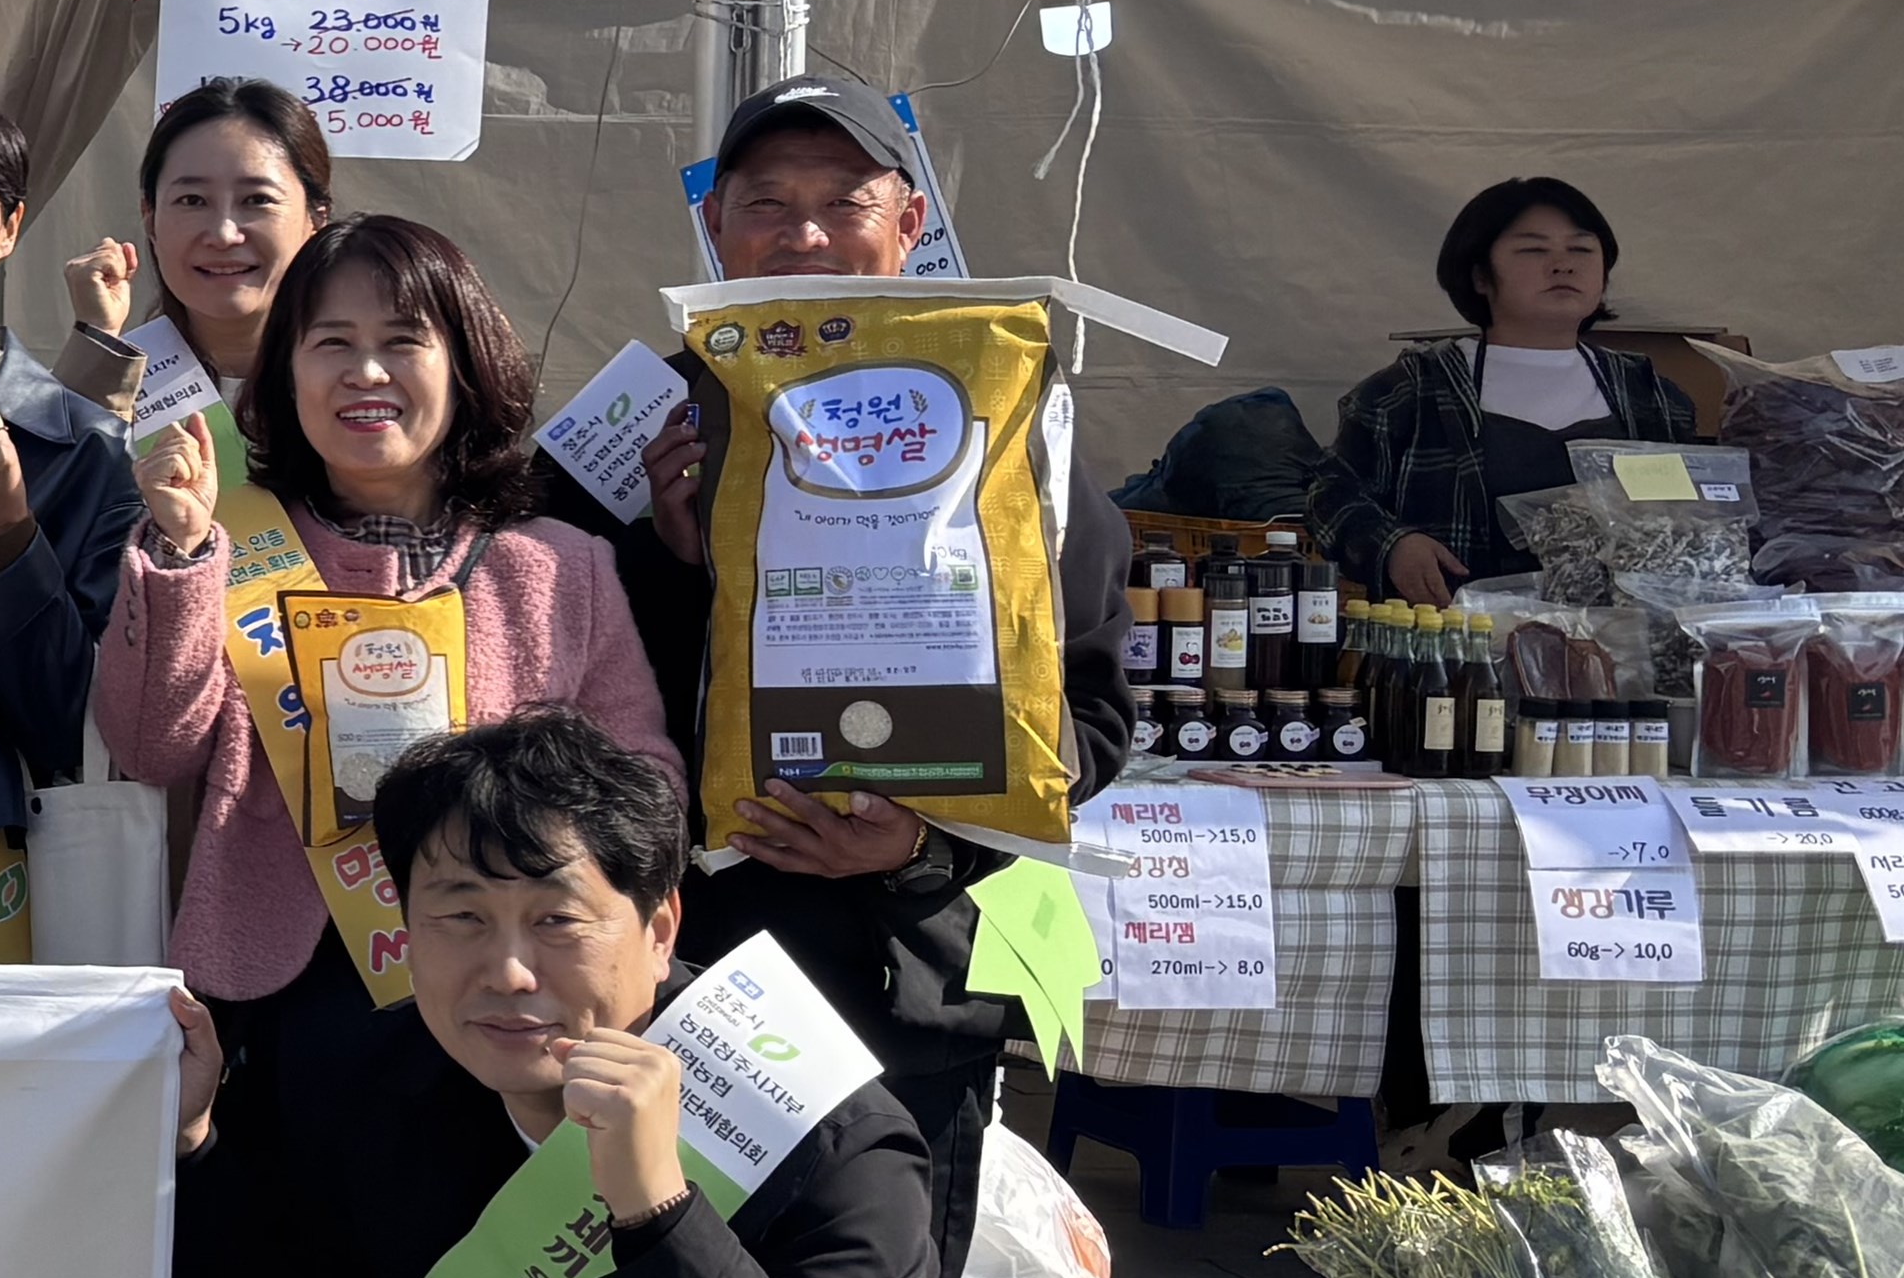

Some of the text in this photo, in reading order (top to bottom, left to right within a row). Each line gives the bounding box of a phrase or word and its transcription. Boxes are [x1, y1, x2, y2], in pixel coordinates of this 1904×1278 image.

[218, 7, 277, 40] 5kg
[309, 109, 435, 135] 5.000원
[821, 393, 905, 428] 청원
[795, 423, 938, 466] 생명쌀
[249, 529, 285, 554] 인증
[353, 659, 417, 680] 생명쌀
[1552, 888, 1676, 920] 생강가루
[1124, 921, 1195, 944] 체리잼
[713, 984, 765, 1031] 청주시
[680, 1013, 805, 1115] 농협청주시지부
